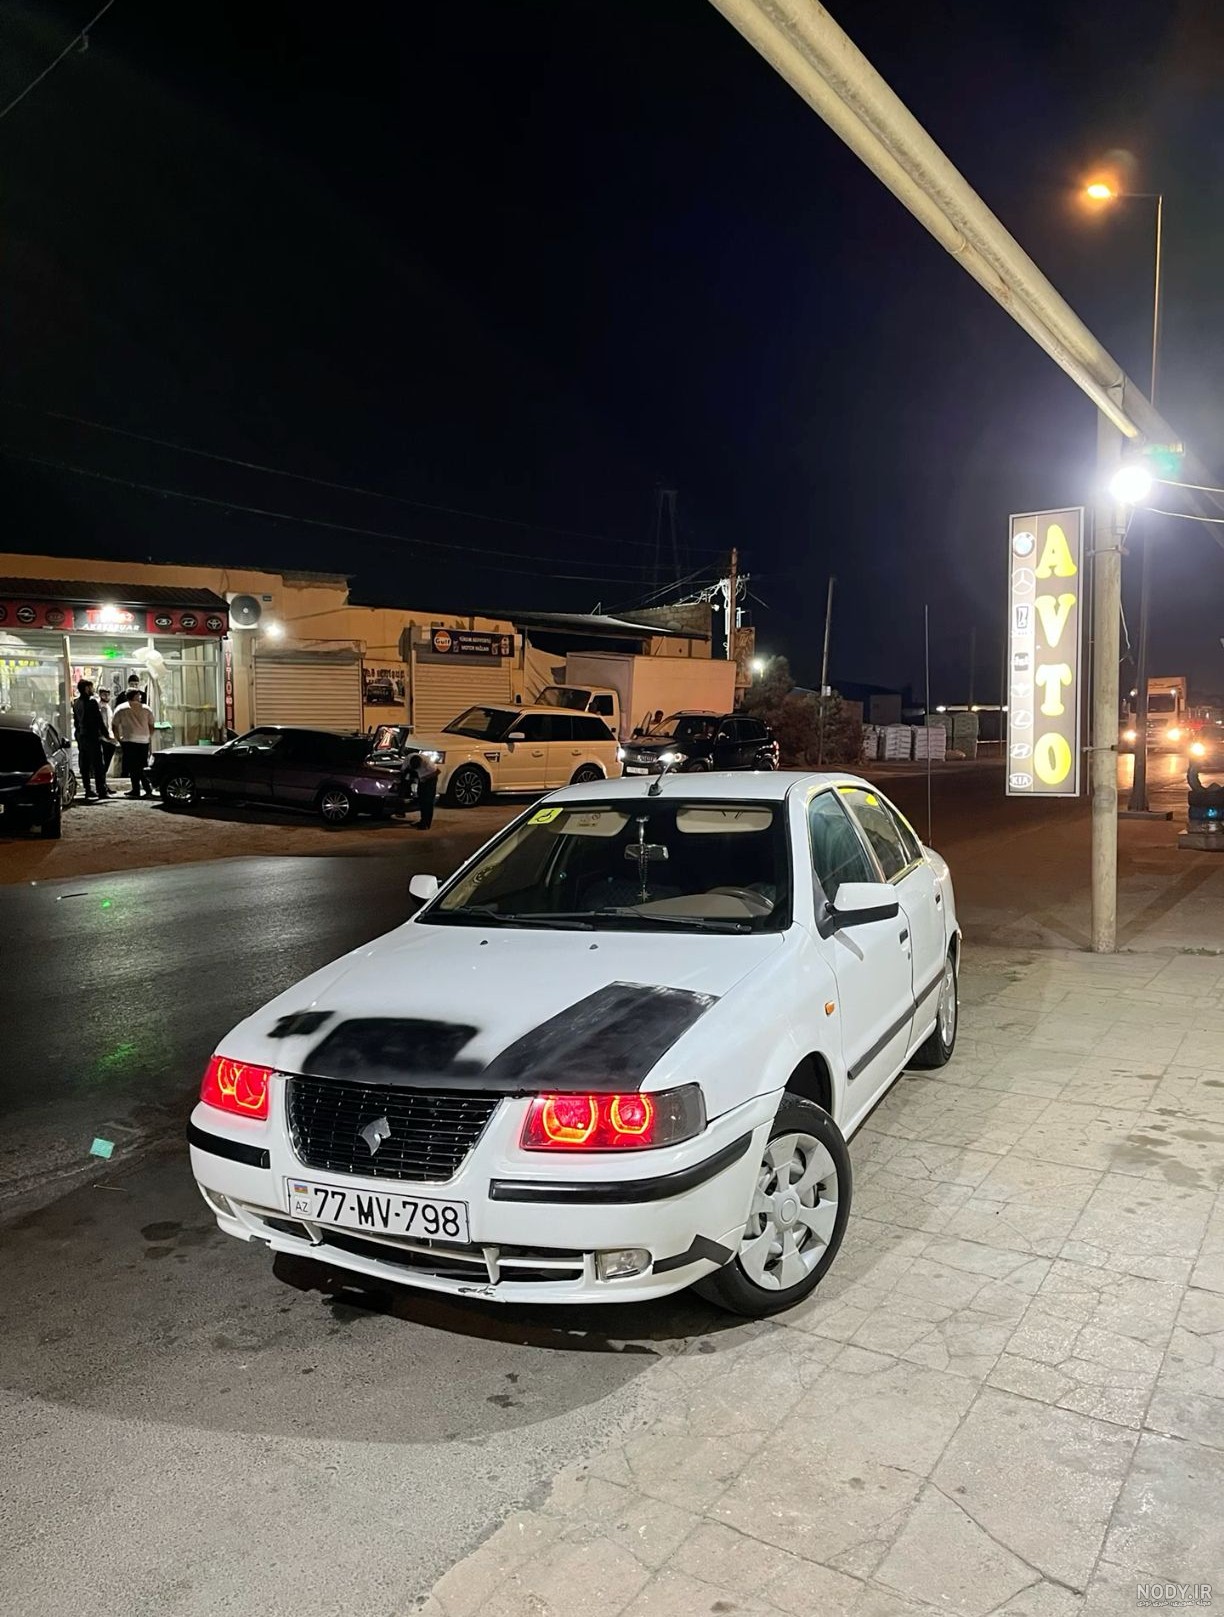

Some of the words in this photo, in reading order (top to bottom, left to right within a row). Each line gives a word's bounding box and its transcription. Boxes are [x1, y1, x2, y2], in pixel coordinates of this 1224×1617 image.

[435, 637, 450, 645] Gulf
[1033, 524, 1077, 784] AVTO
[1012, 776, 1029, 785] KIA
[296, 1200, 308, 1212] AZ
[314, 1188, 460, 1237] 77-MV-798
